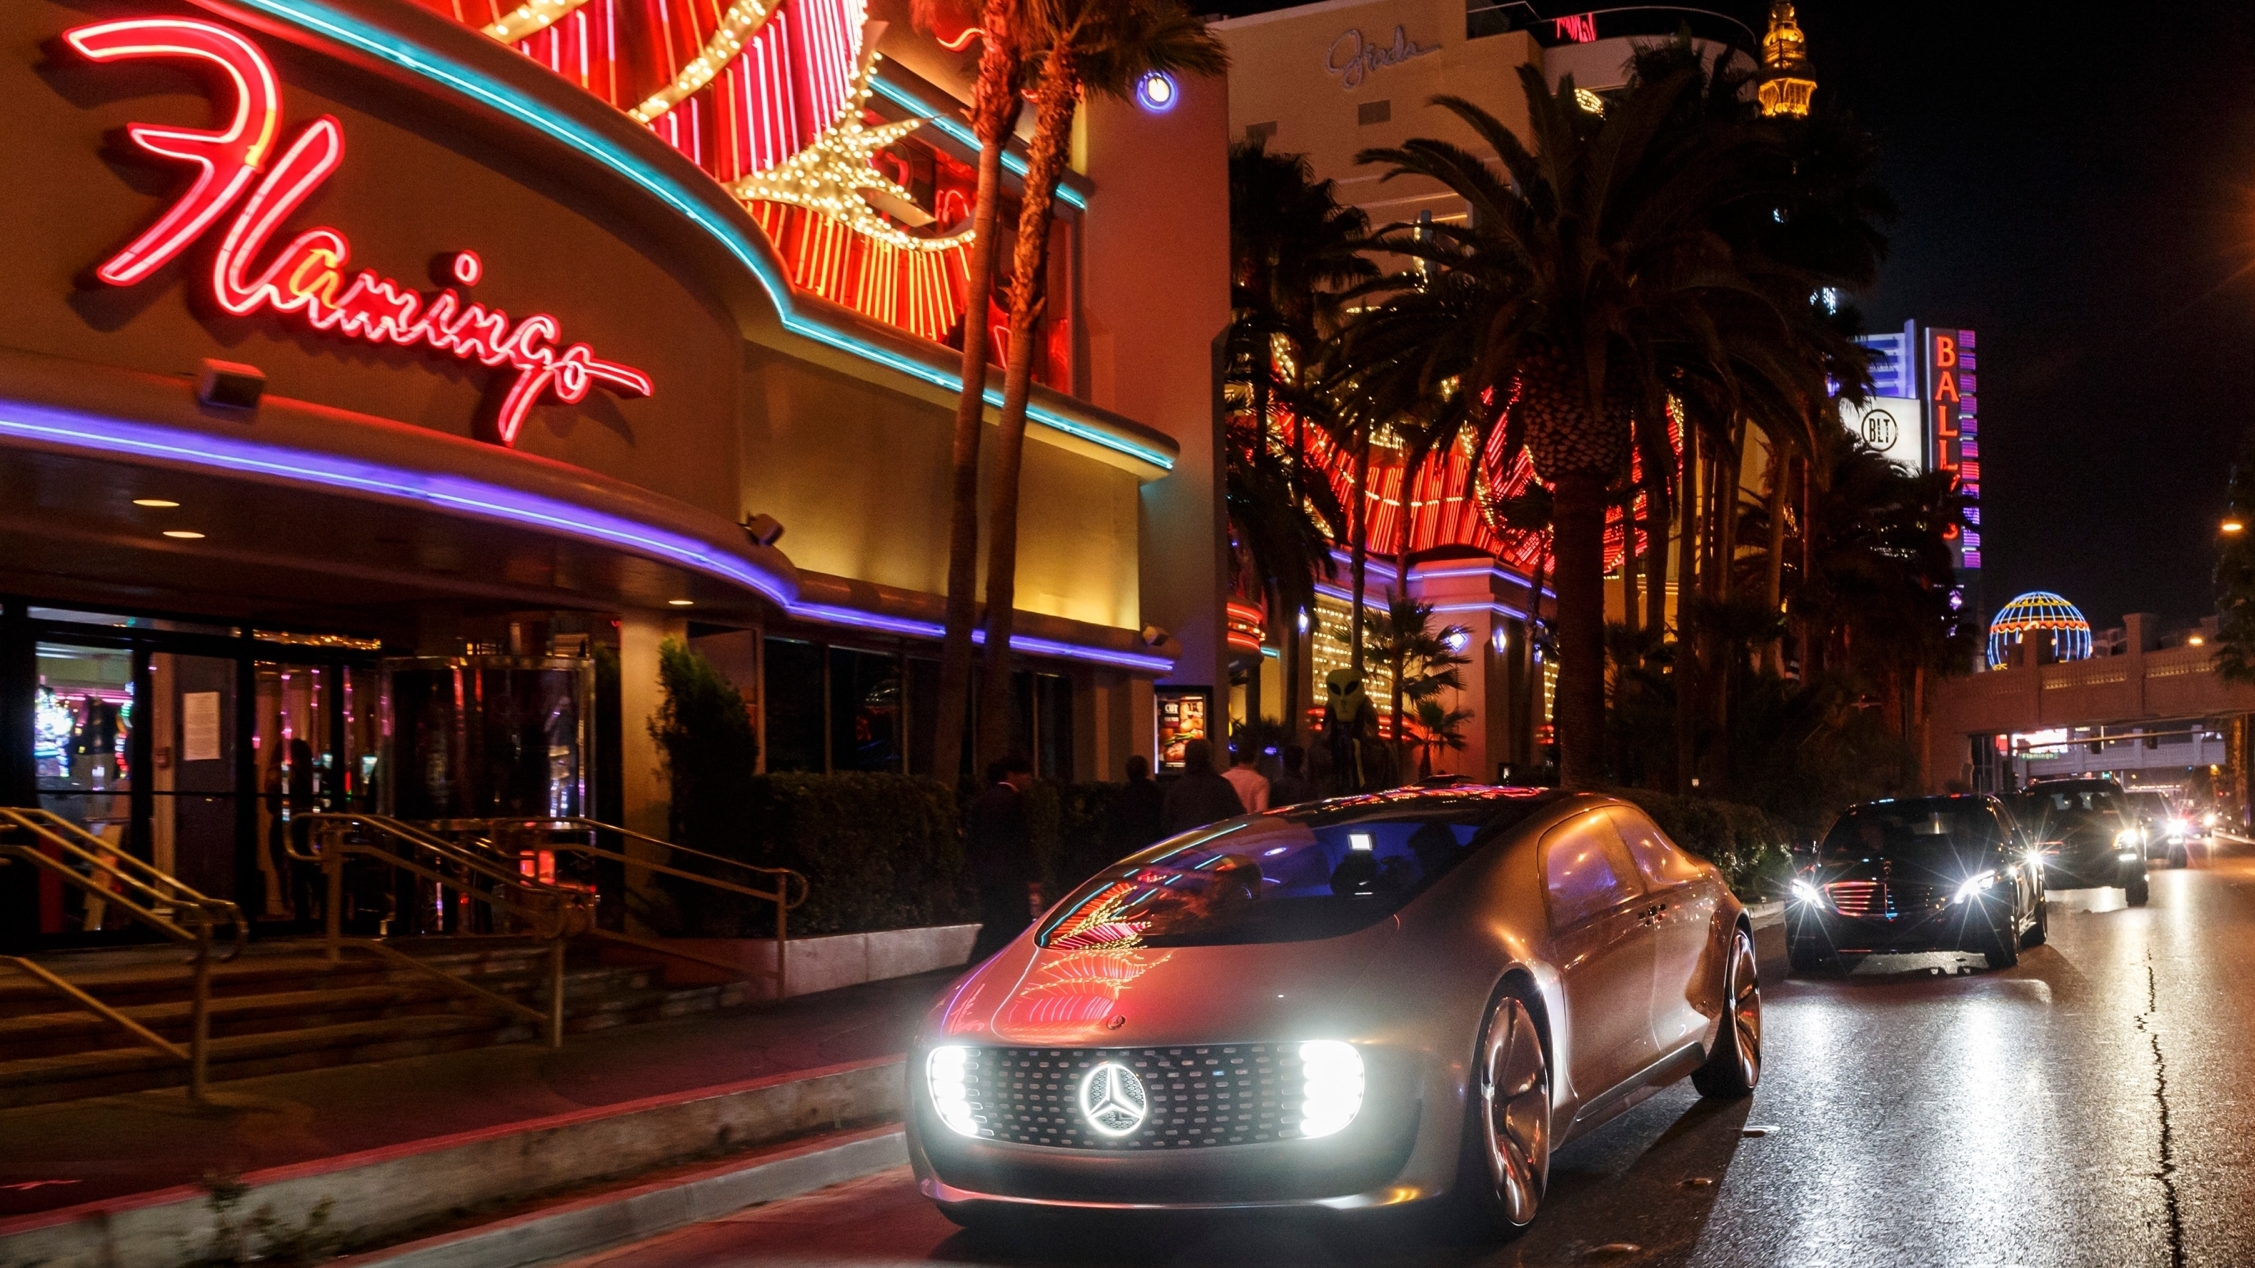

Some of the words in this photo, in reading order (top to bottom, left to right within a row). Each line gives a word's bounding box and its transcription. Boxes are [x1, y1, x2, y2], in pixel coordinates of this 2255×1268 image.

[62, 17, 654, 448] Flamingo
[1869, 418, 1890, 443] BLT
[1935, 336, 1961, 540] BALL
